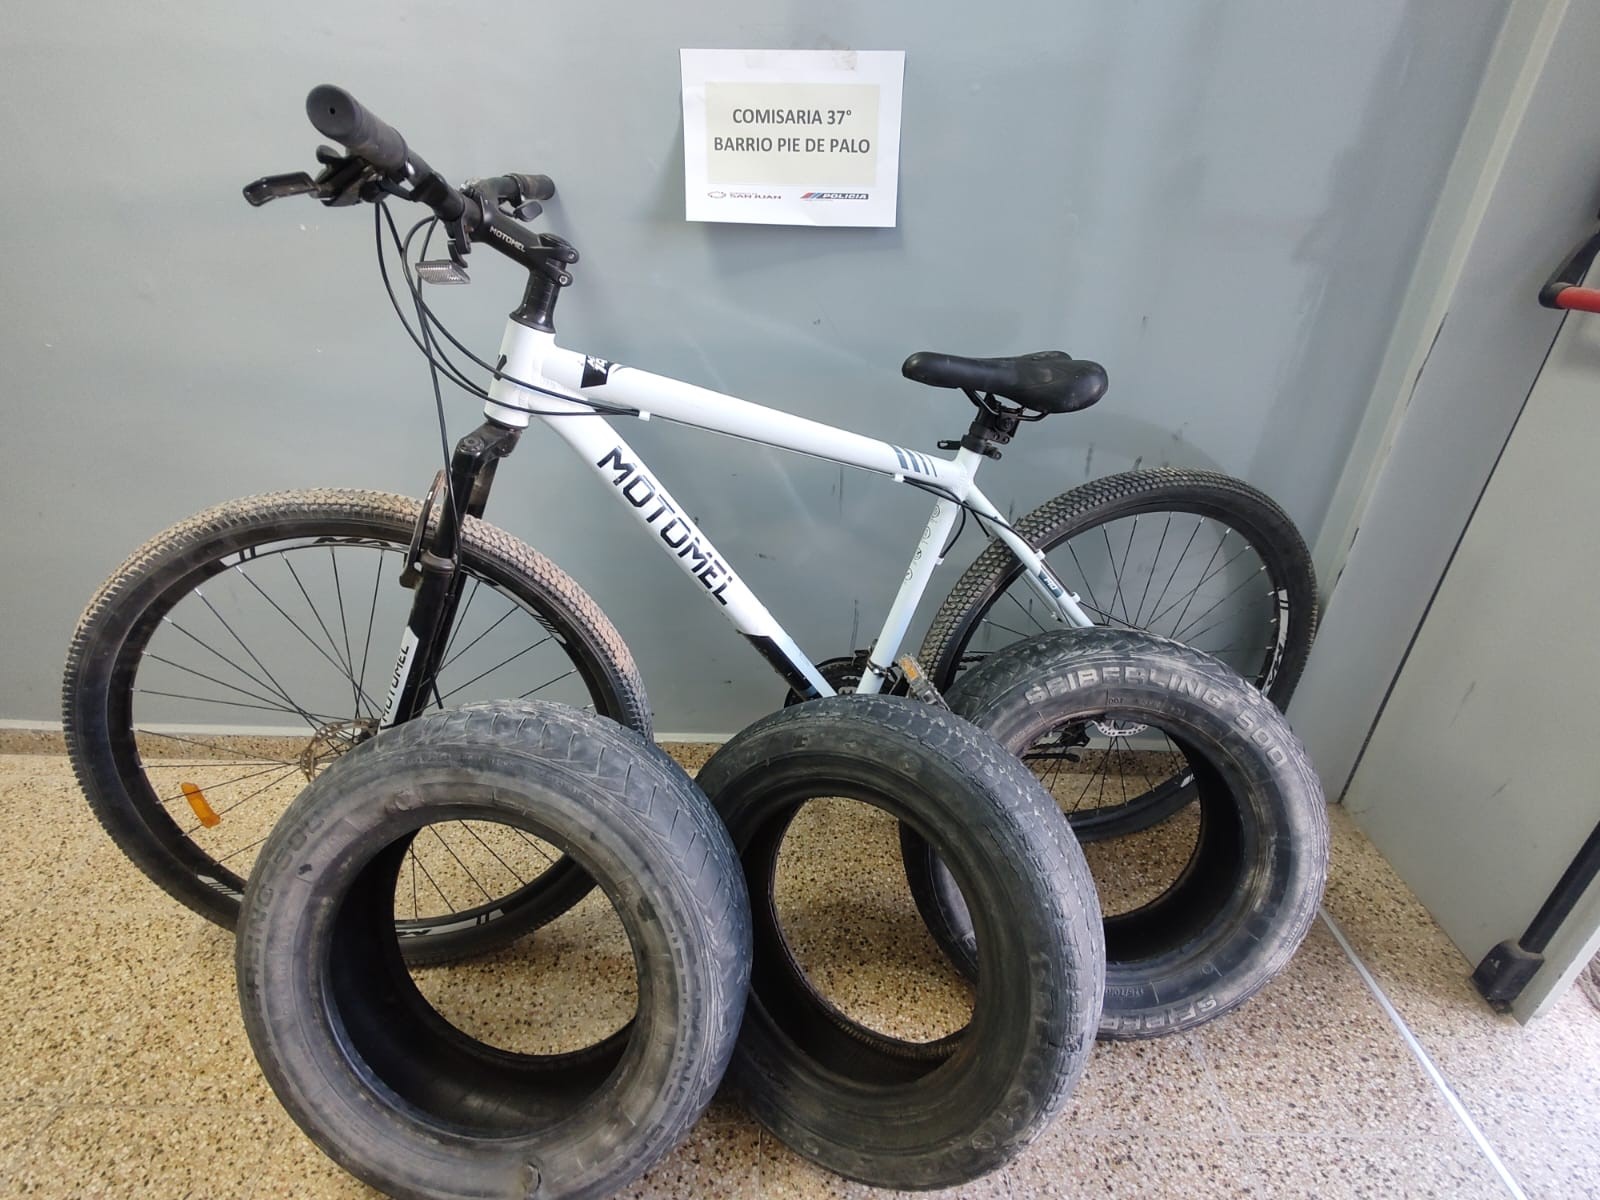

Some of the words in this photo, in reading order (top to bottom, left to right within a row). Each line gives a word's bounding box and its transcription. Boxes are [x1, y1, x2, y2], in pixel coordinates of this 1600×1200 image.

[732, 108, 823, 125] COMISARIA
[714, 137, 773, 152] BARRIO
[778, 138, 800, 152] PIE
[805, 138, 825, 153] DE
[830, 138, 871, 154] PALO
[489, 225, 527, 253] MOTOMEL
[596, 445, 733, 606] MOTOMEL
[381, 645, 410, 722] MOTOMEL
[1024, 666, 1223, 708] SEIBERLING
[1233, 711, 1288, 768] 500
